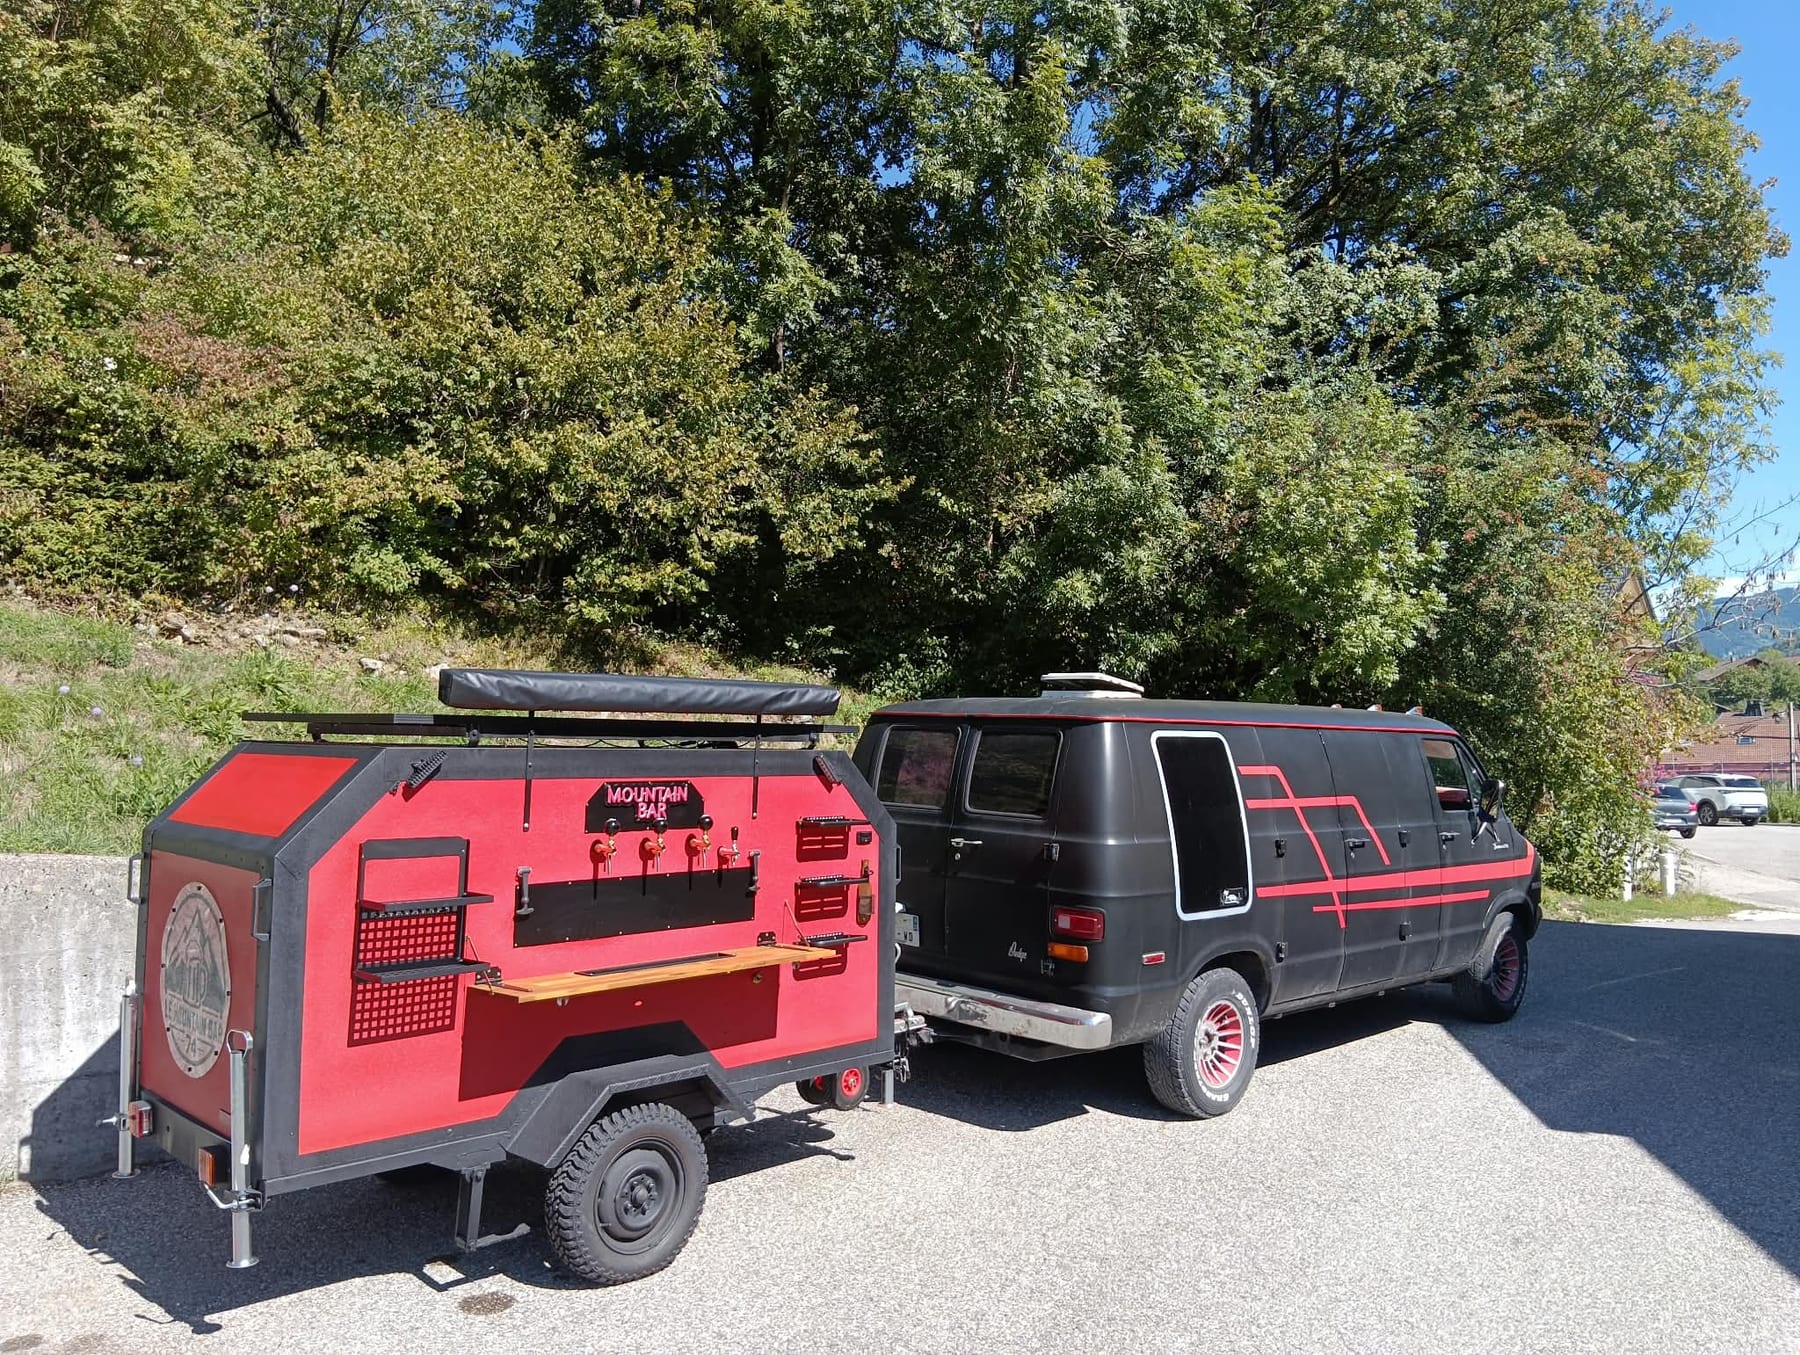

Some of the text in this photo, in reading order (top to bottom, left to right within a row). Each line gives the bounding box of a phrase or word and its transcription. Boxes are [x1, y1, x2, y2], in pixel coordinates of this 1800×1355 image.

[607, 785, 689, 804] MOUNTAIN
[637, 802, 668, 820] BAR
[1235, 992, 1256, 1048] DUNLOP
[185, 1033, 197, 1057] 74
